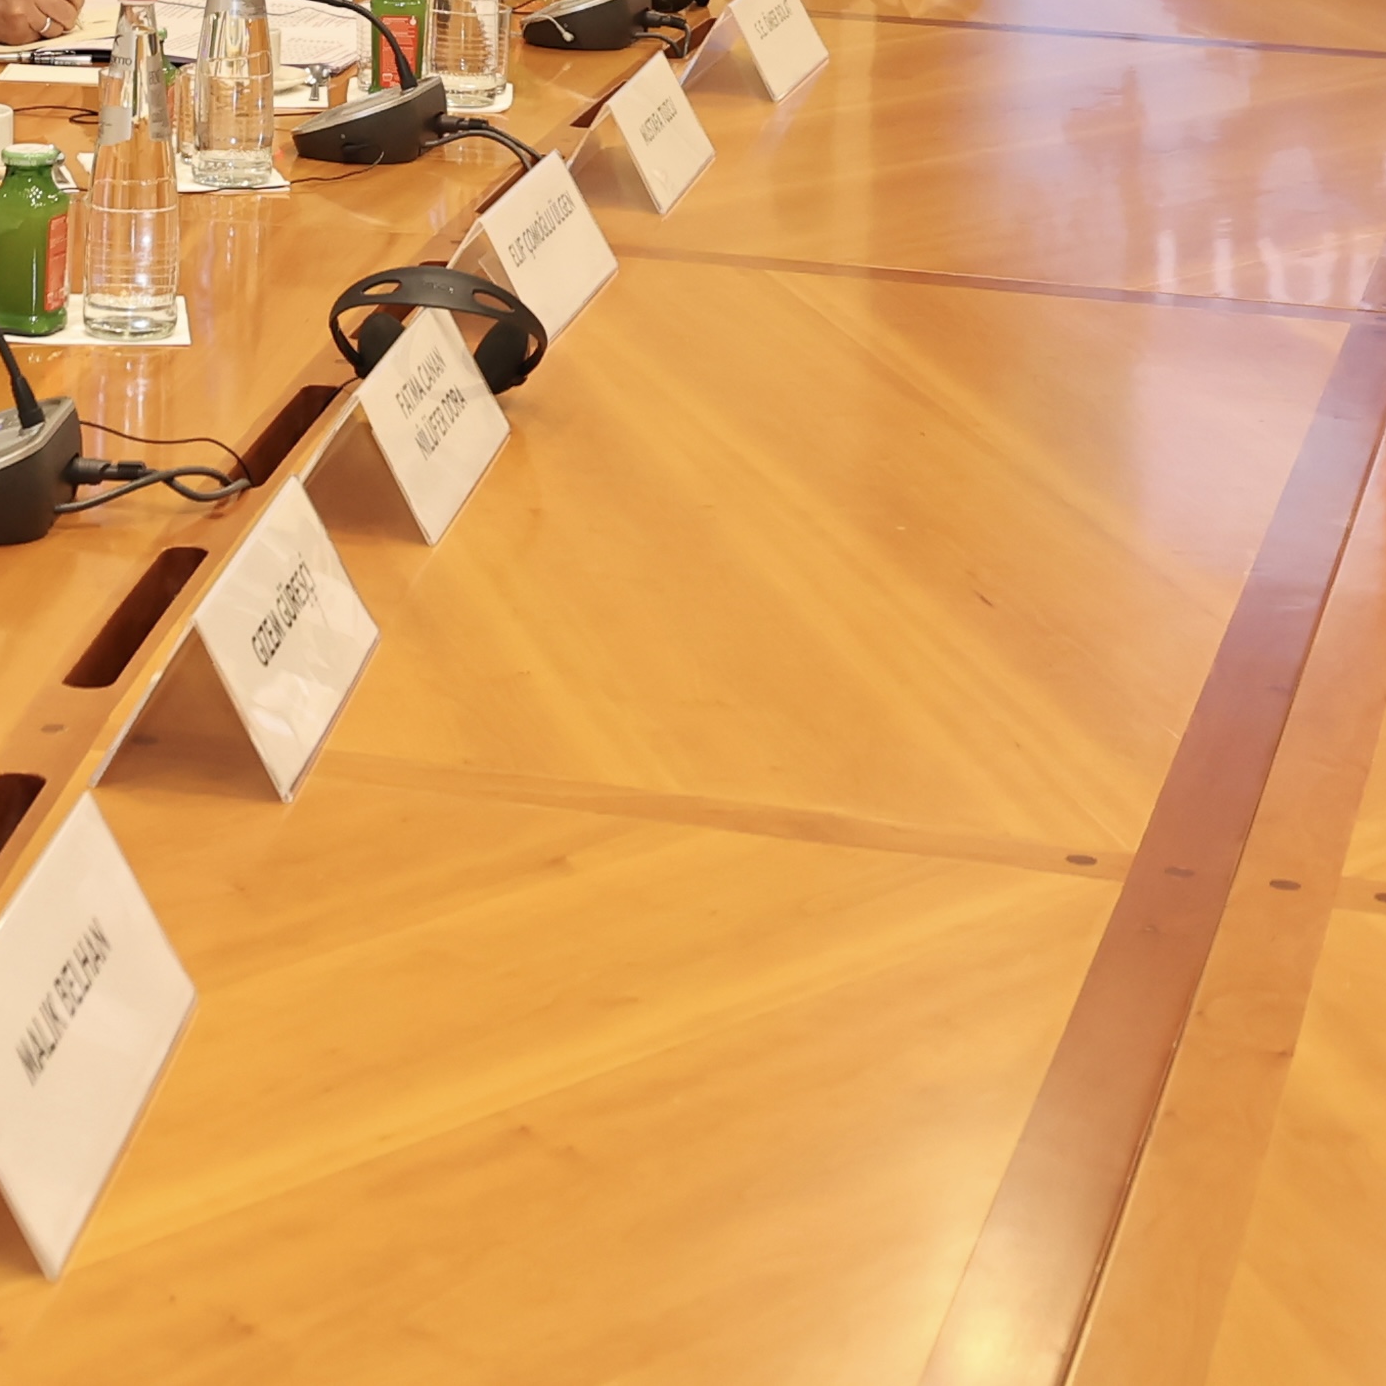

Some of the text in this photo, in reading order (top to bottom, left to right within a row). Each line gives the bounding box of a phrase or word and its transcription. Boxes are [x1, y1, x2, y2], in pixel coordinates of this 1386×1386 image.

[507, 236, 527, 269] ELIF
[548, 189, 577, 226] ÜLGEN
[395, 345, 447, 420] FATMA CANAN
[440, 383, 468, 425] DORA
[14, 915, 113, 1088] MALIK BELHAN
